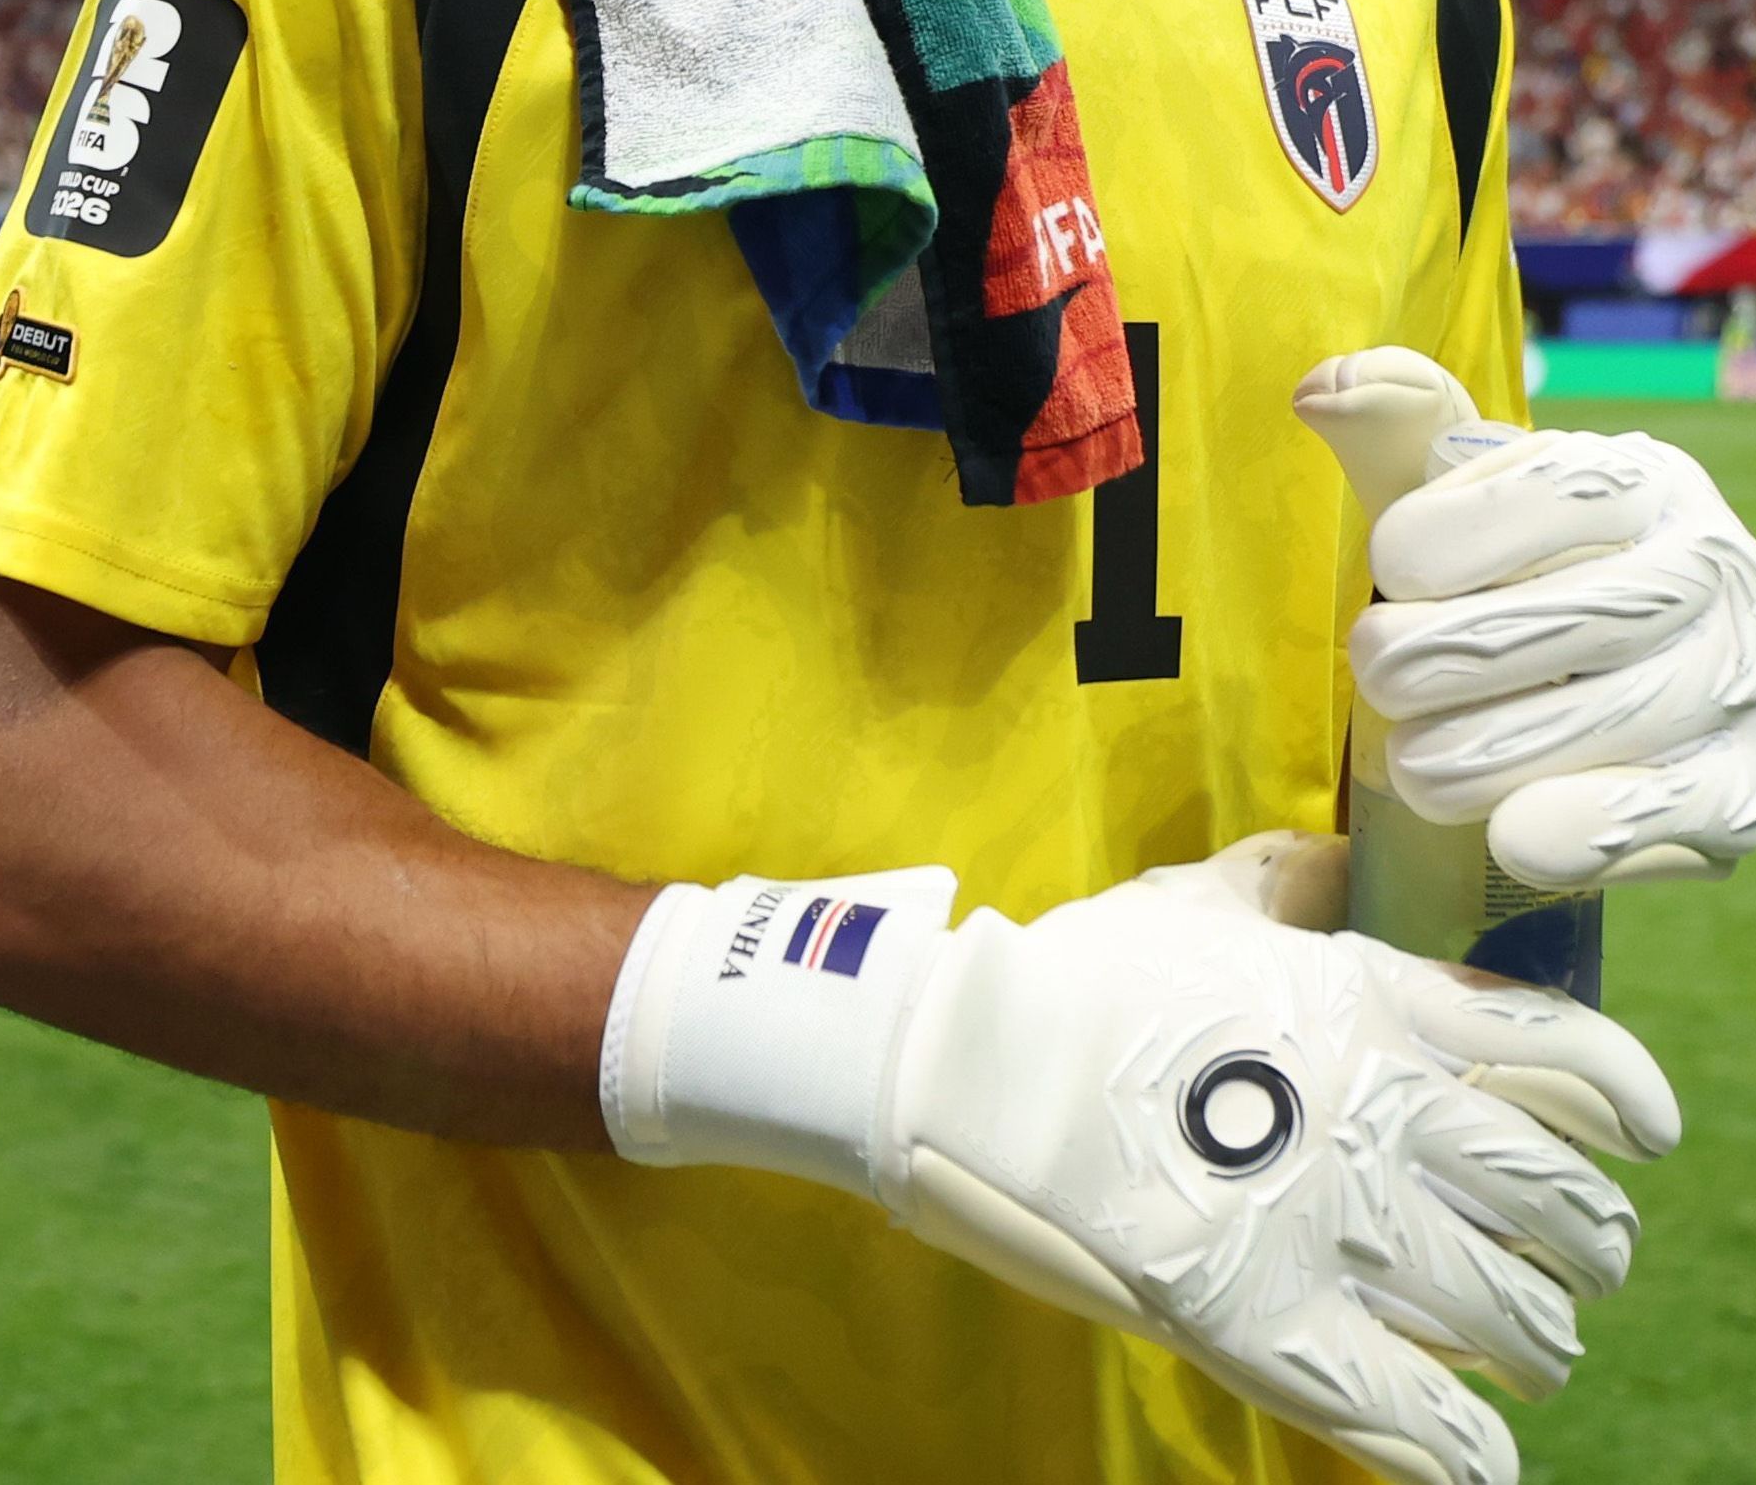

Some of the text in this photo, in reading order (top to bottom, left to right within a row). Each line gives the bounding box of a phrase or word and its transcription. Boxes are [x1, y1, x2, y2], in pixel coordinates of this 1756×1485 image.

[76, 130, 106, 152] FIFA
[81, 174, 121, 198] CUP
[49, 189, 112, 226] 2026
[11, 322, 70, 354] DEBUT
[1074, 321, 1183, 685] 1
[717, 885, 795, 982] ZINHA
